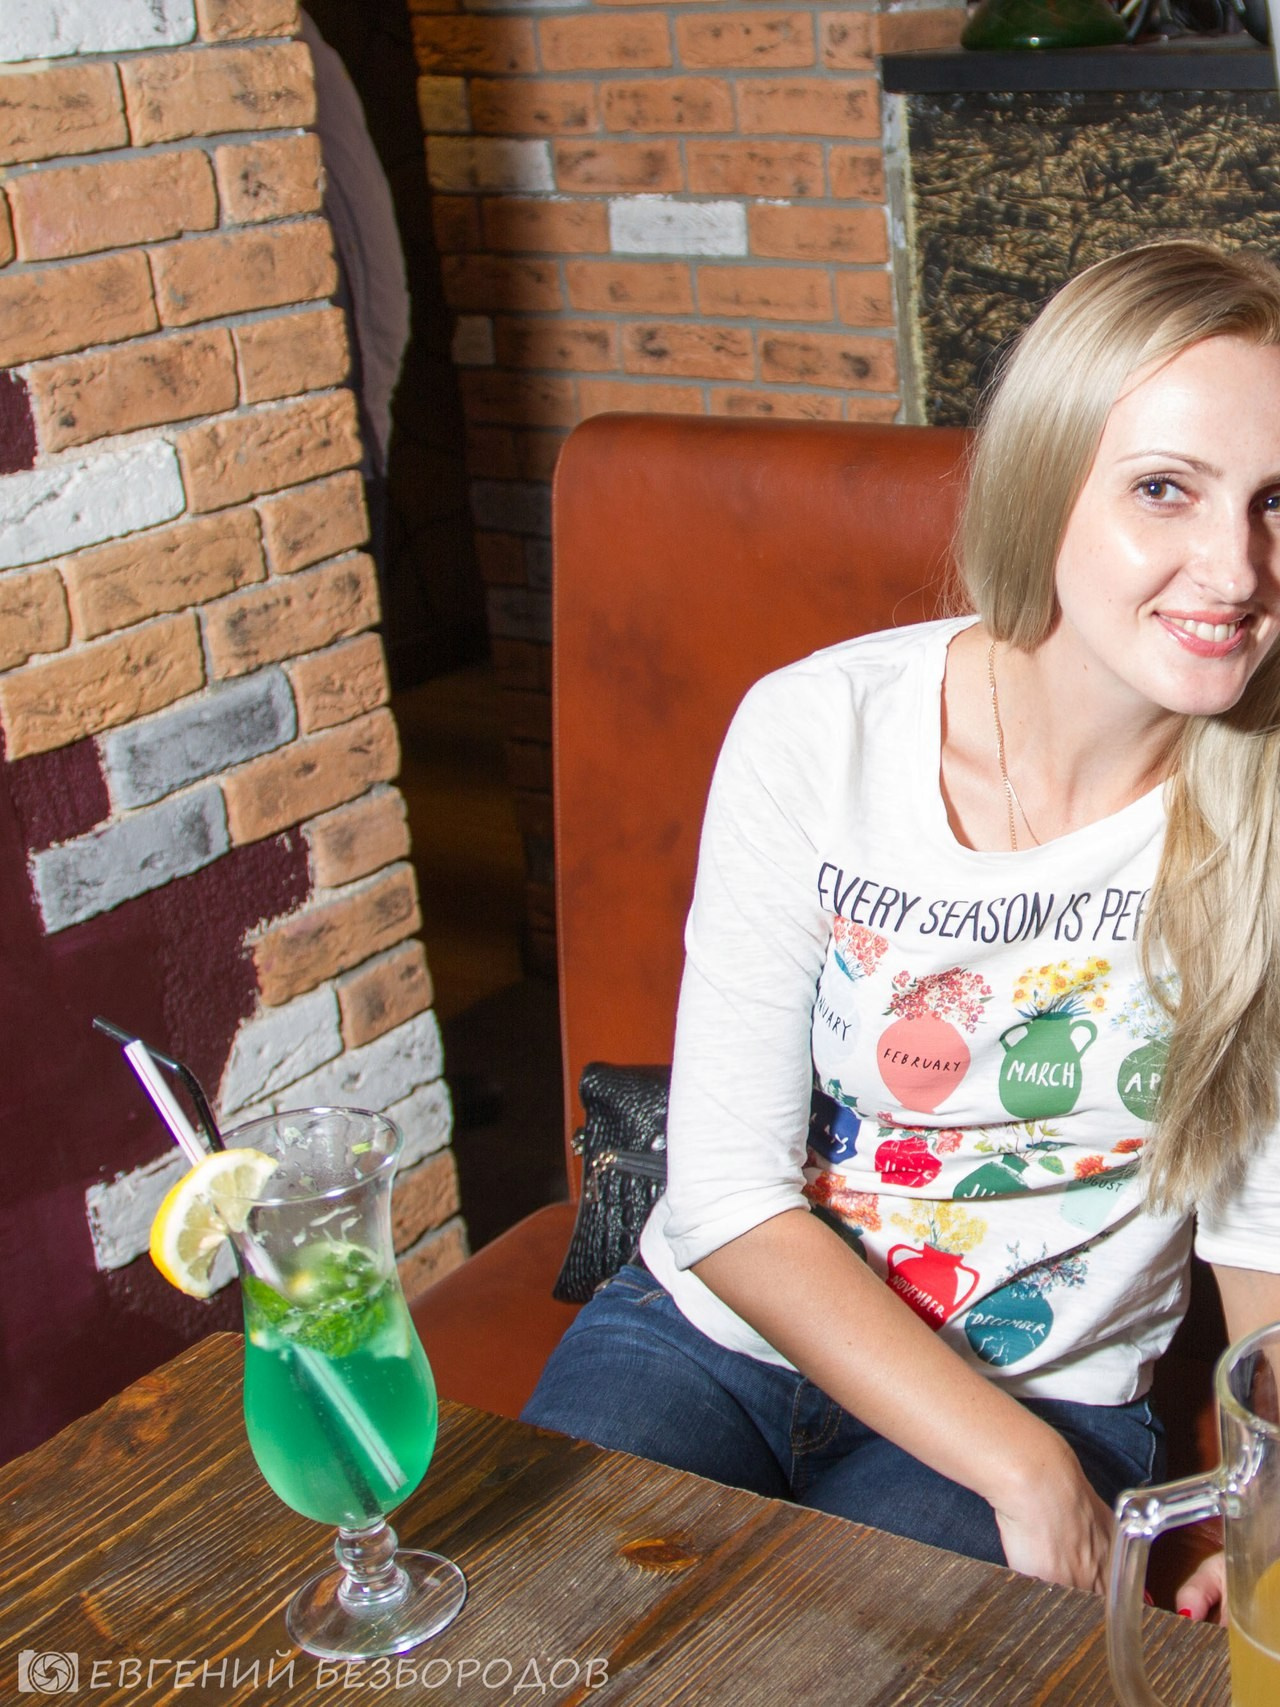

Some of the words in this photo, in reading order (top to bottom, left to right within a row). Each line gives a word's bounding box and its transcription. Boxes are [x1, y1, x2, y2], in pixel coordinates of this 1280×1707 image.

[817, 862, 922, 932] EVERY
[919, 892, 1054, 944] SEASON
[1054, 892, 1091, 942] IS
[883, 1047, 961, 1073] FEBRUARY
[1006, 1059, 1075, 1088] MARCH
[891, 1274, 945, 1319] NOVEMBER
[971, 1311, 1046, 1337] DECEMBER
